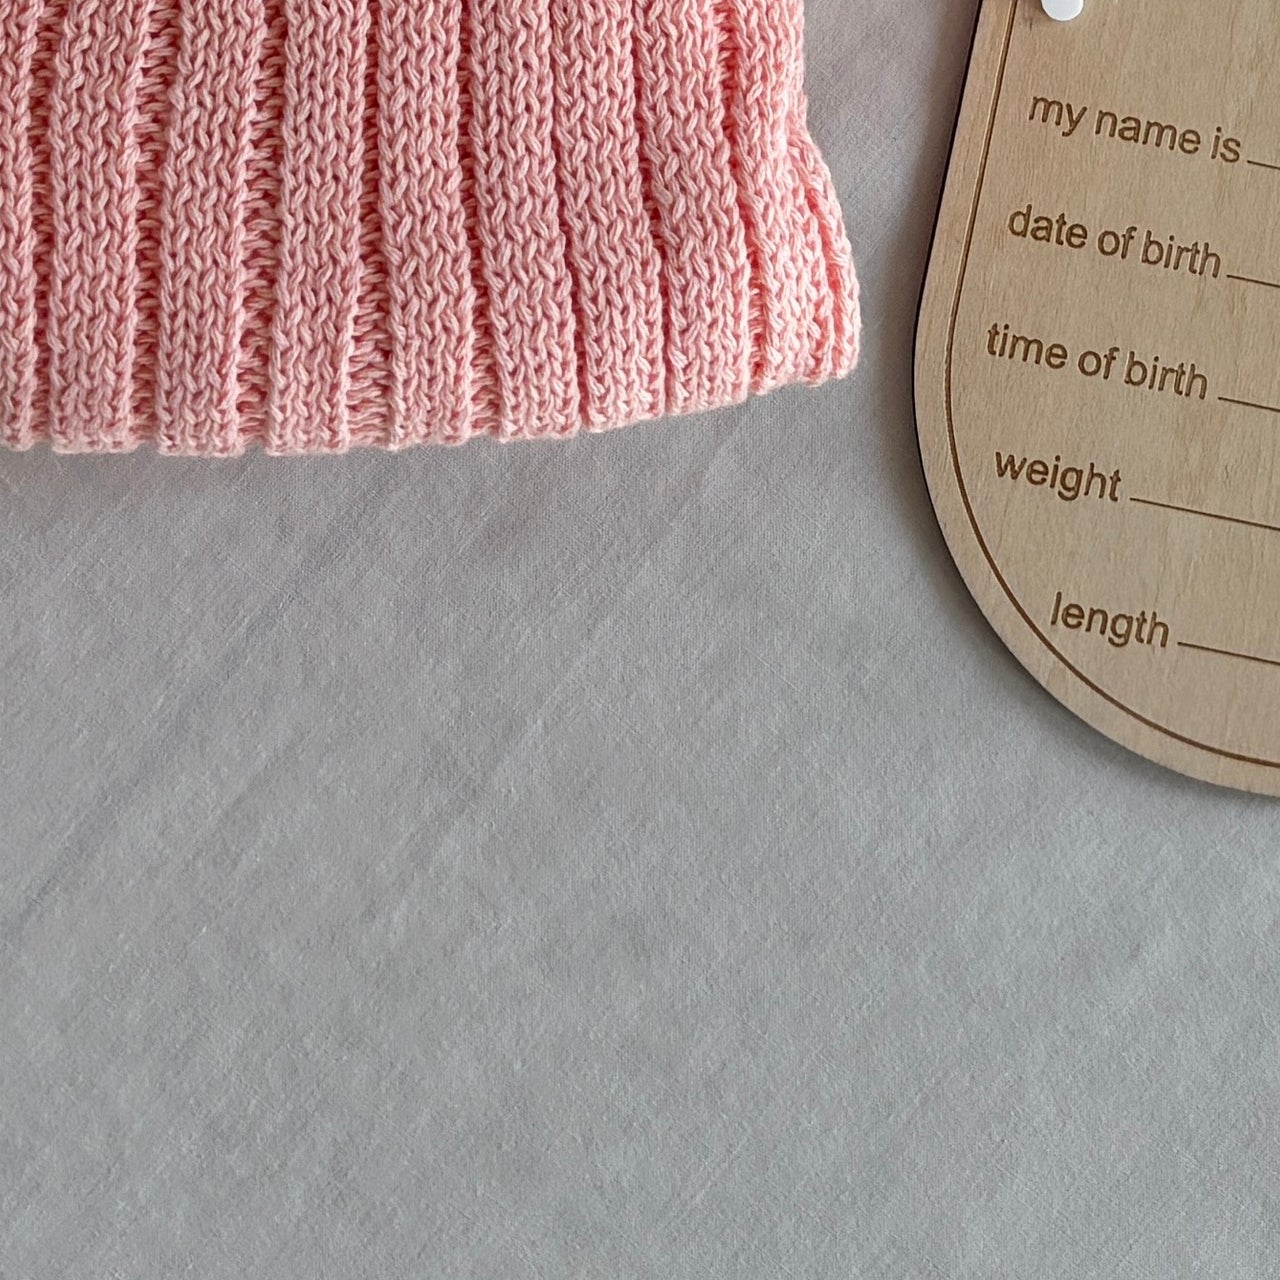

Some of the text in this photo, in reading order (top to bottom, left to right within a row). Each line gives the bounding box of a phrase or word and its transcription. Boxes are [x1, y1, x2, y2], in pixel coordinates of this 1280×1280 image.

[1029, 96, 1241, 163] my name is
[1008, 204, 1221, 278] date of birth
[987, 323, 1208, 400] time of birth
[995, 451, 1121, 501] weight
[1050, 592, 1170, 648] length
